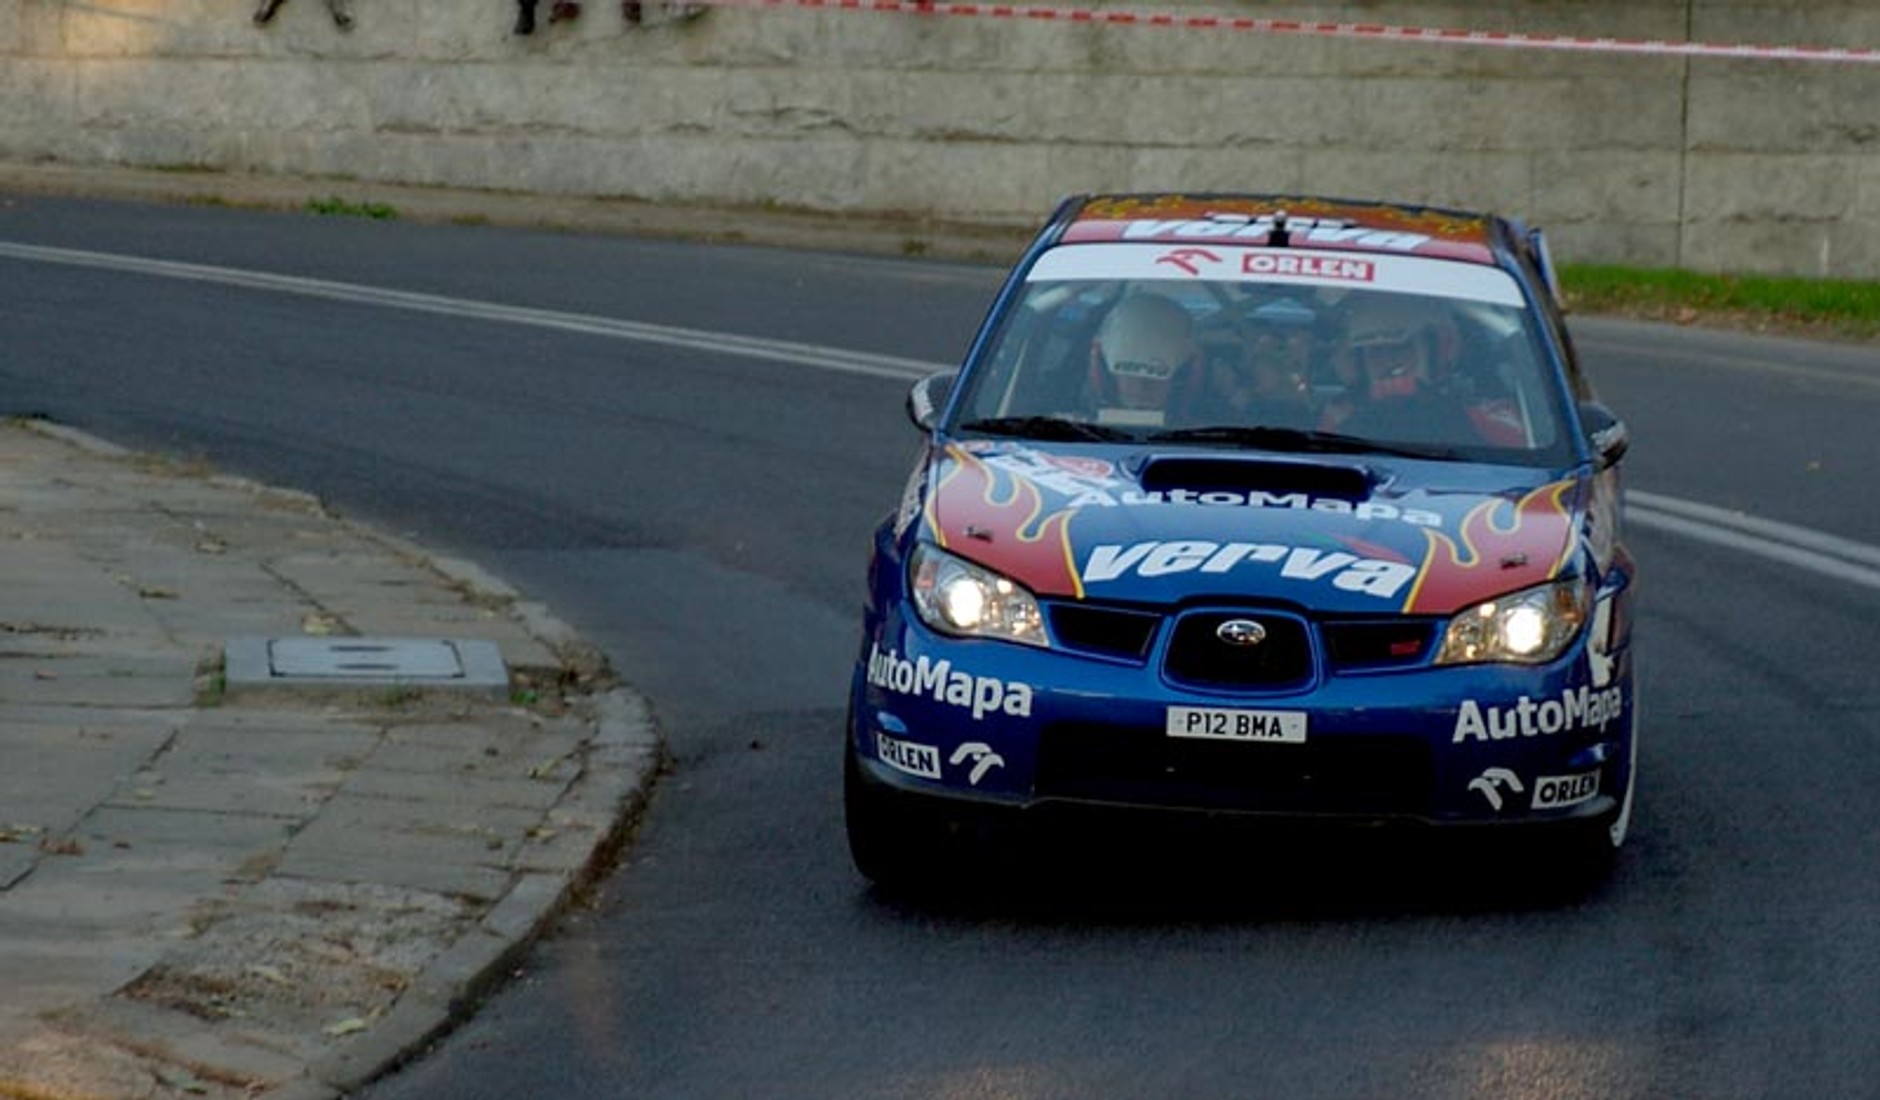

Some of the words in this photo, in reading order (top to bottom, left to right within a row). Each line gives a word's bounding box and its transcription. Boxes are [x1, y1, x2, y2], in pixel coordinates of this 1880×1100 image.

[1248, 254, 1371, 281] ORLEN
[1067, 488, 1443, 528] AutoMapa
[1082, 540, 1417, 599] verva
[867, 641, 1034, 721] AutoMapa
[1186, 711, 1228, 735] P12
[1235, 714, 1283, 738] BMA
[1452, 685, 1622, 744] AutoMapa
[879, 734, 935, 773] ORLEN
